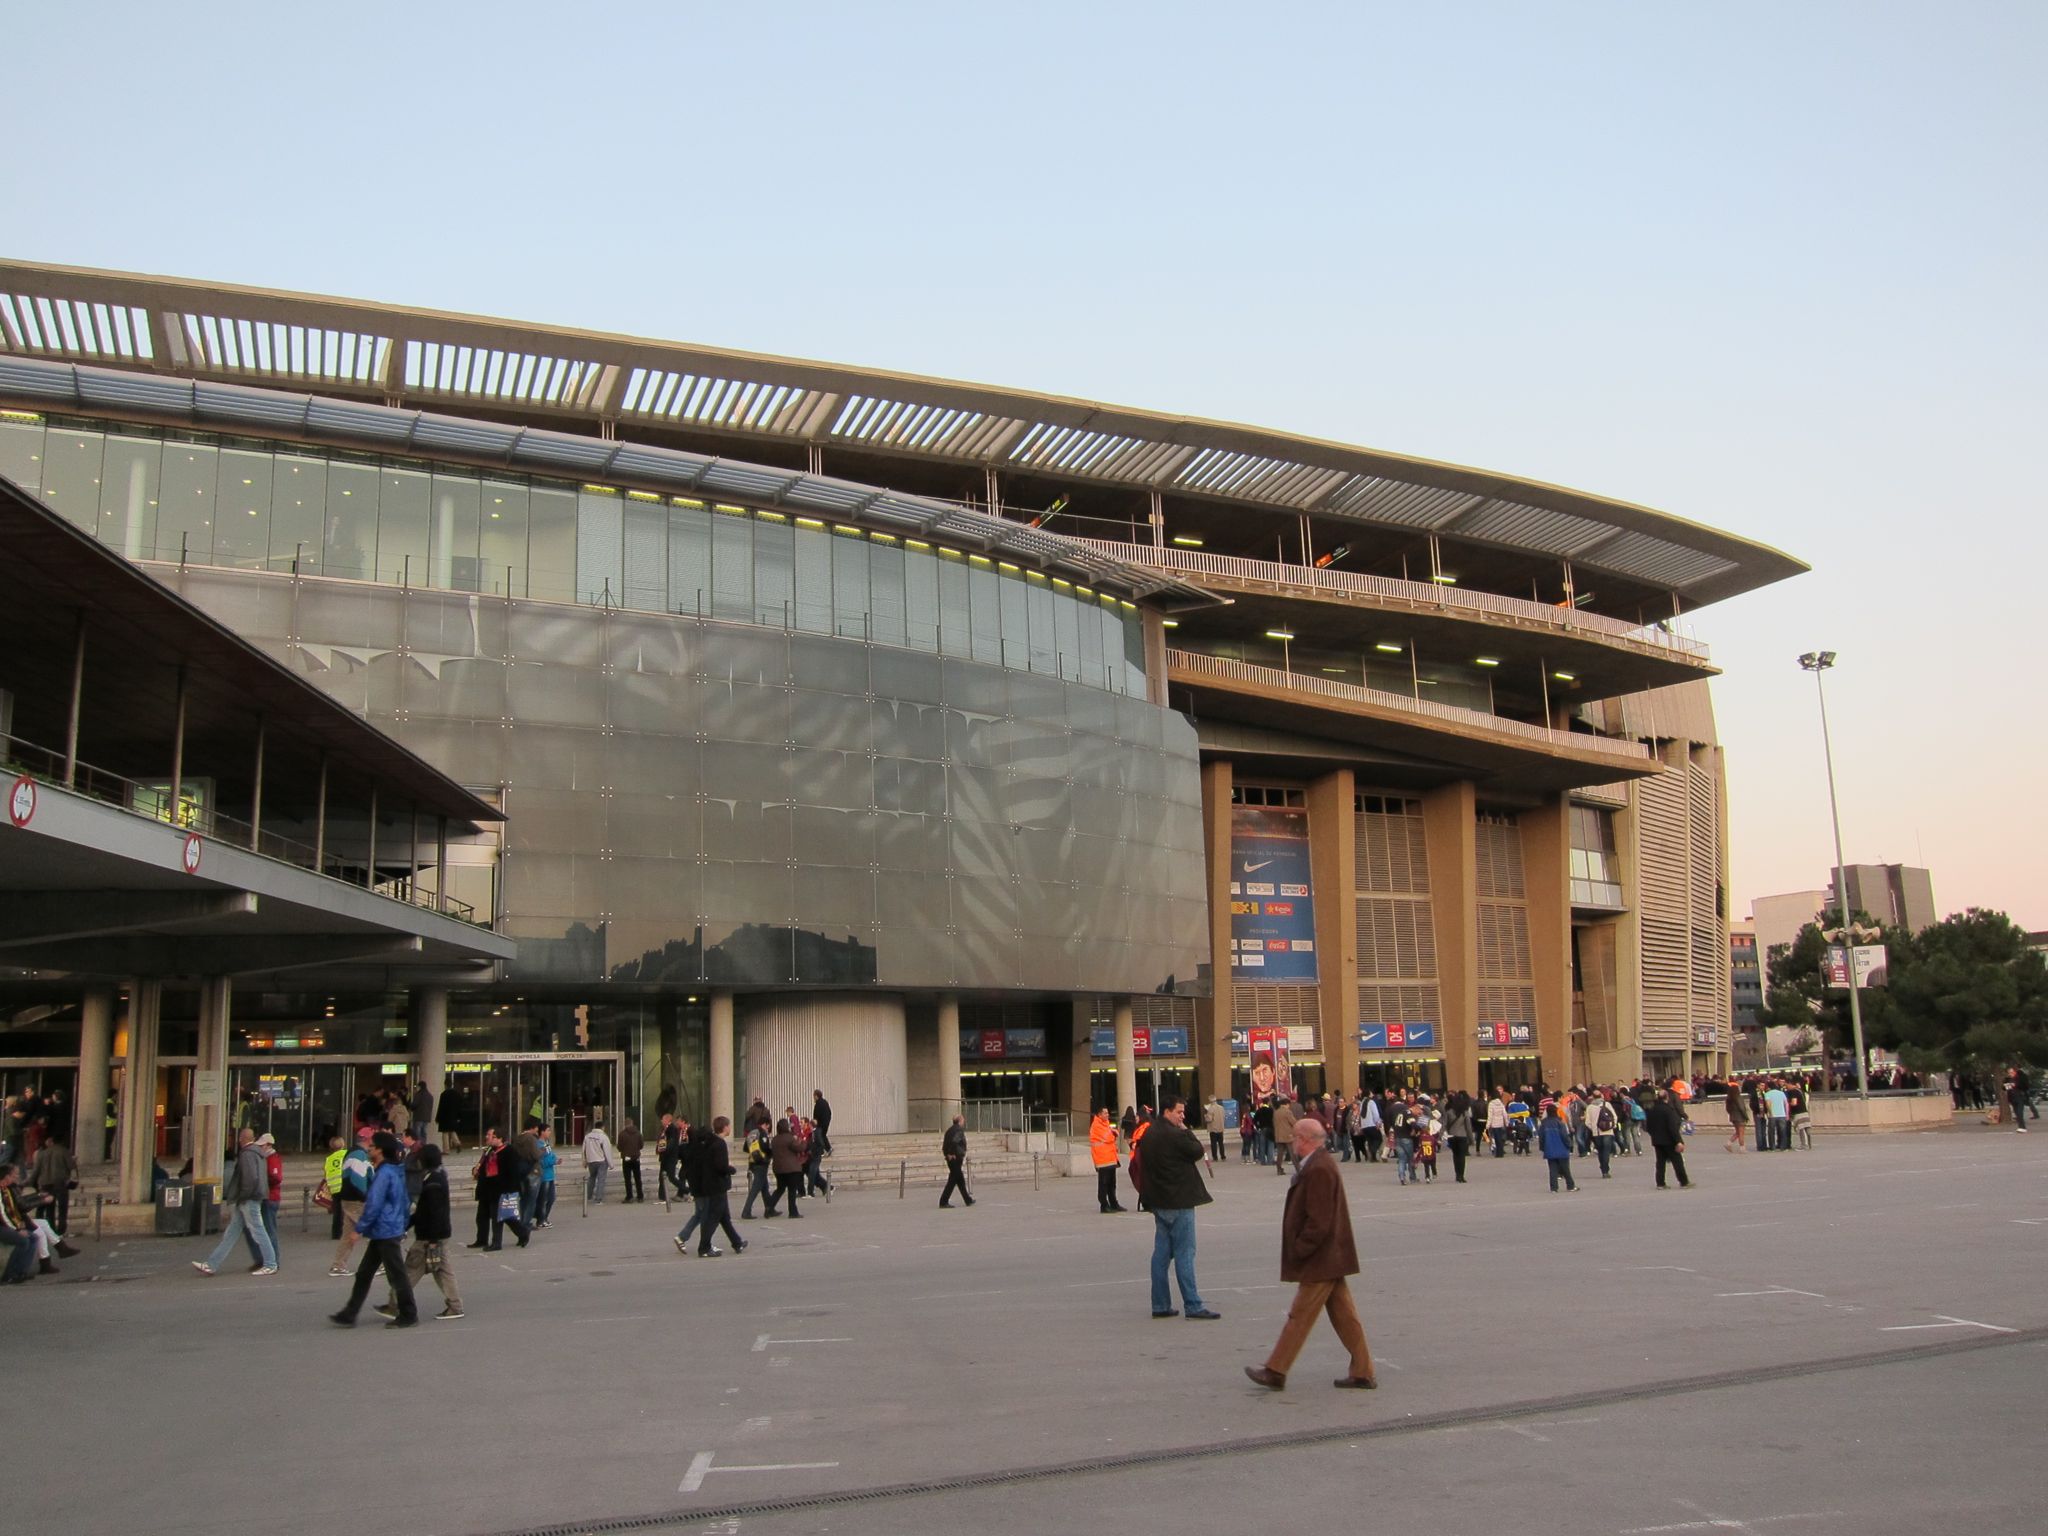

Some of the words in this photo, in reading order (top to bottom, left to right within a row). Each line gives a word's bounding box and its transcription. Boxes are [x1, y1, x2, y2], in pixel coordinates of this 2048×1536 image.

[1389, 1032, 1403, 1042] 25
[1511, 1026, 1530, 1038] DiR
[984, 1040, 1002, 1052] 22
[1132, 1038, 1148, 1049] 23
[1422, 1145, 1432, 1156] 10
